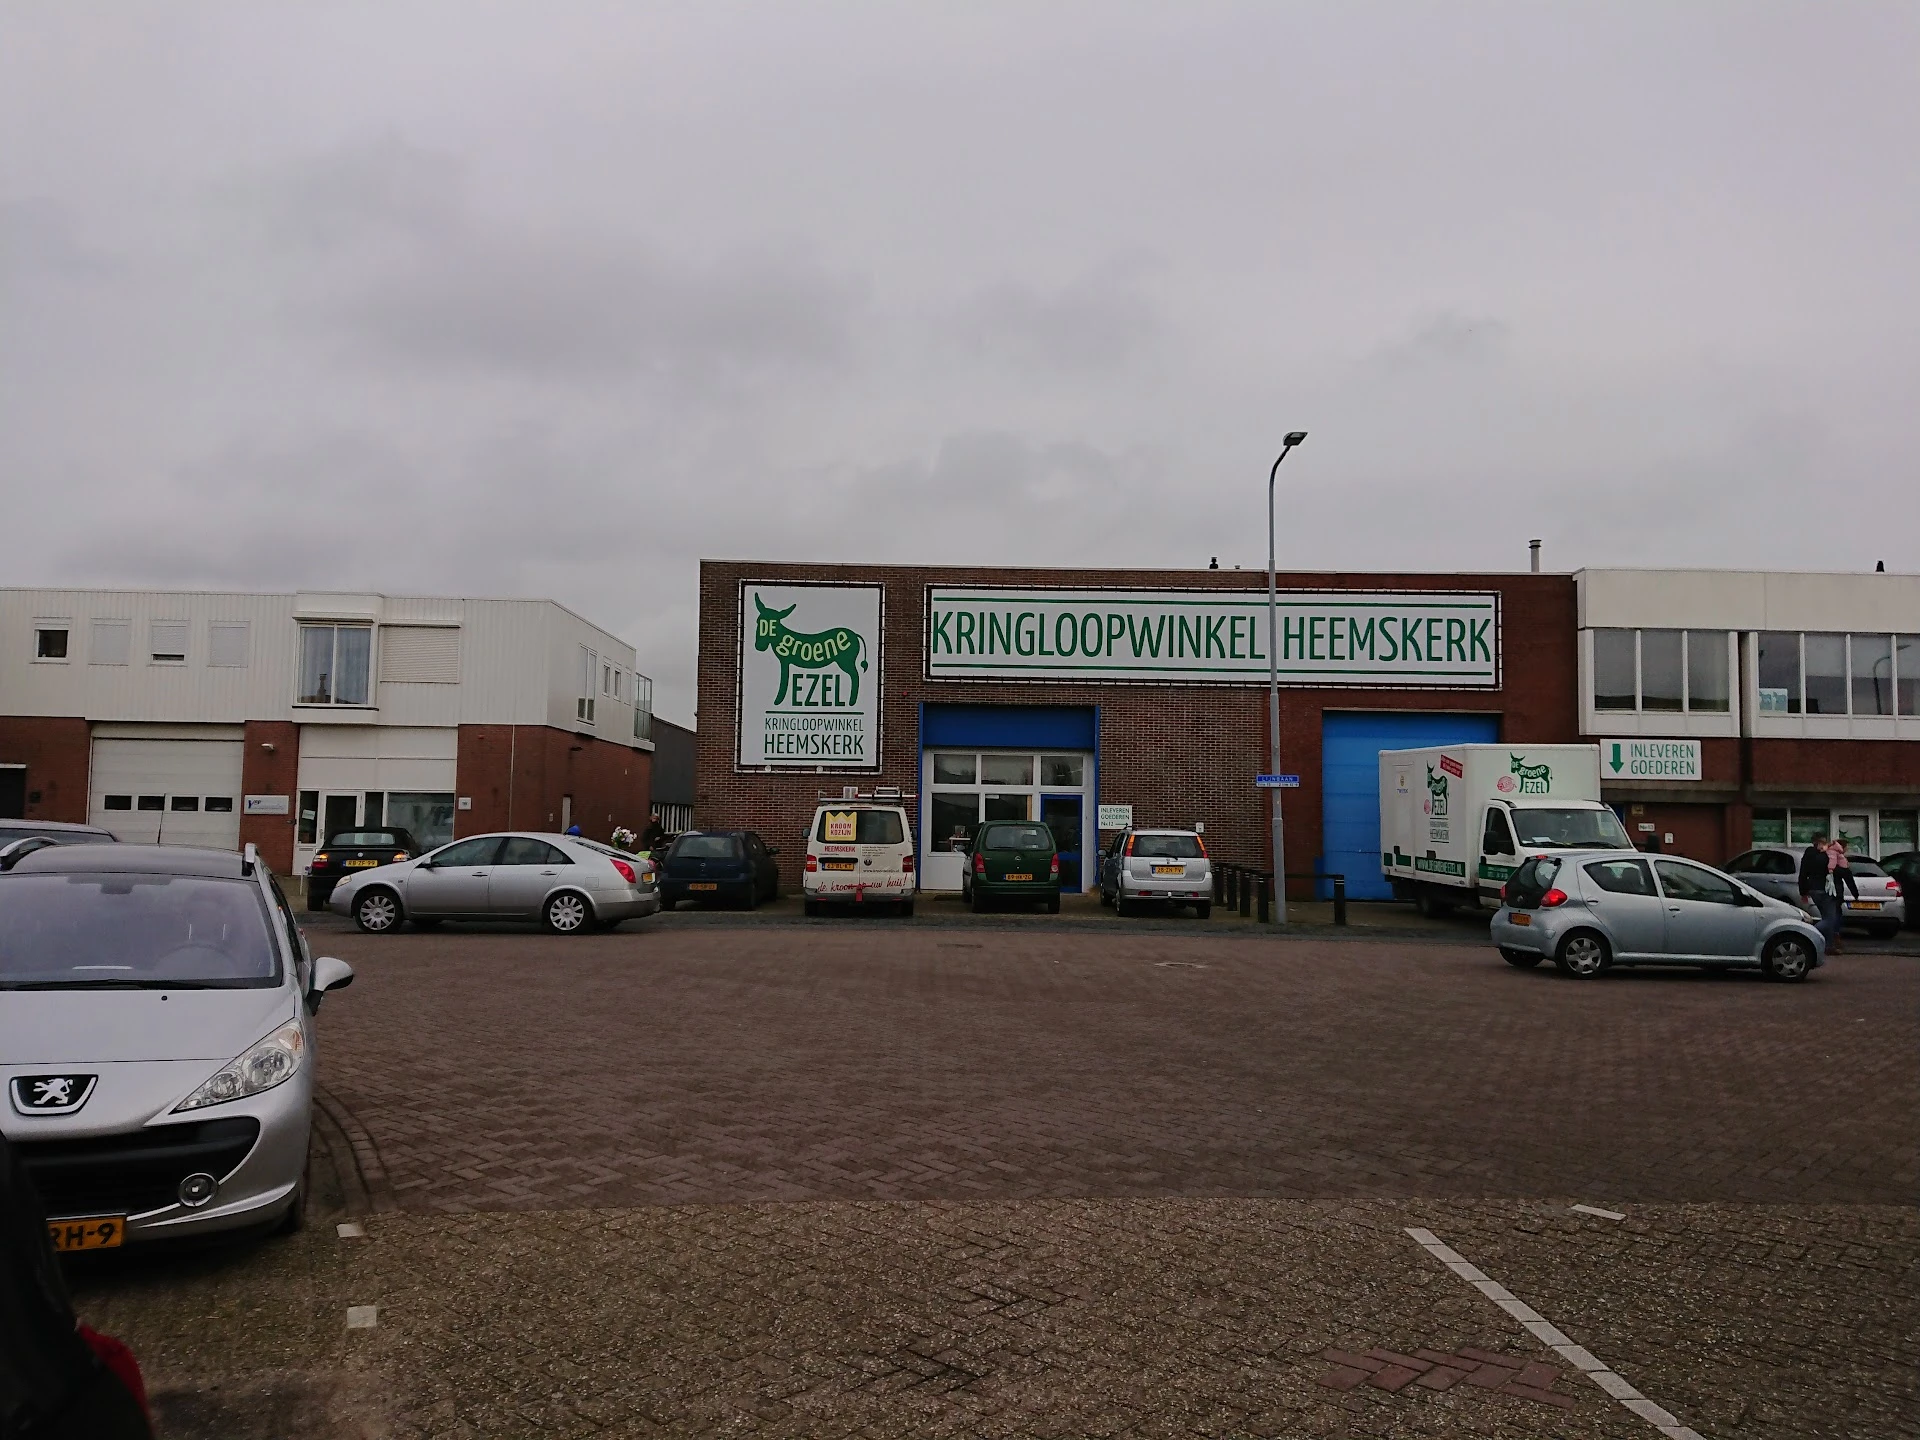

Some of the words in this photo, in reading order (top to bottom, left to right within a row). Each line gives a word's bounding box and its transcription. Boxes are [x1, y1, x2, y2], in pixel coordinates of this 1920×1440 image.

[759, 619, 777, 637] DE
[932, 611, 1266, 659] KRINGLOOPWINKEL
[1283, 616, 1491, 662] HEEMSKERK
[775, 631, 851, 662] groene
[791, 673, 846, 707] EZEL
[765, 717, 864, 732] KRINGLOOPWINKEL
[764, 733, 864, 755] HEEMSKERK
[1630, 743, 1695, 759] INLEVEREN
[1519, 765, 1546, 778] groene
[1630, 759, 1695, 775] GOEDEREN
[1525, 781, 1546, 794] EZEL
[824, 845, 856, 853] HEEMSKERK
[818, 881, 827, 892] de
